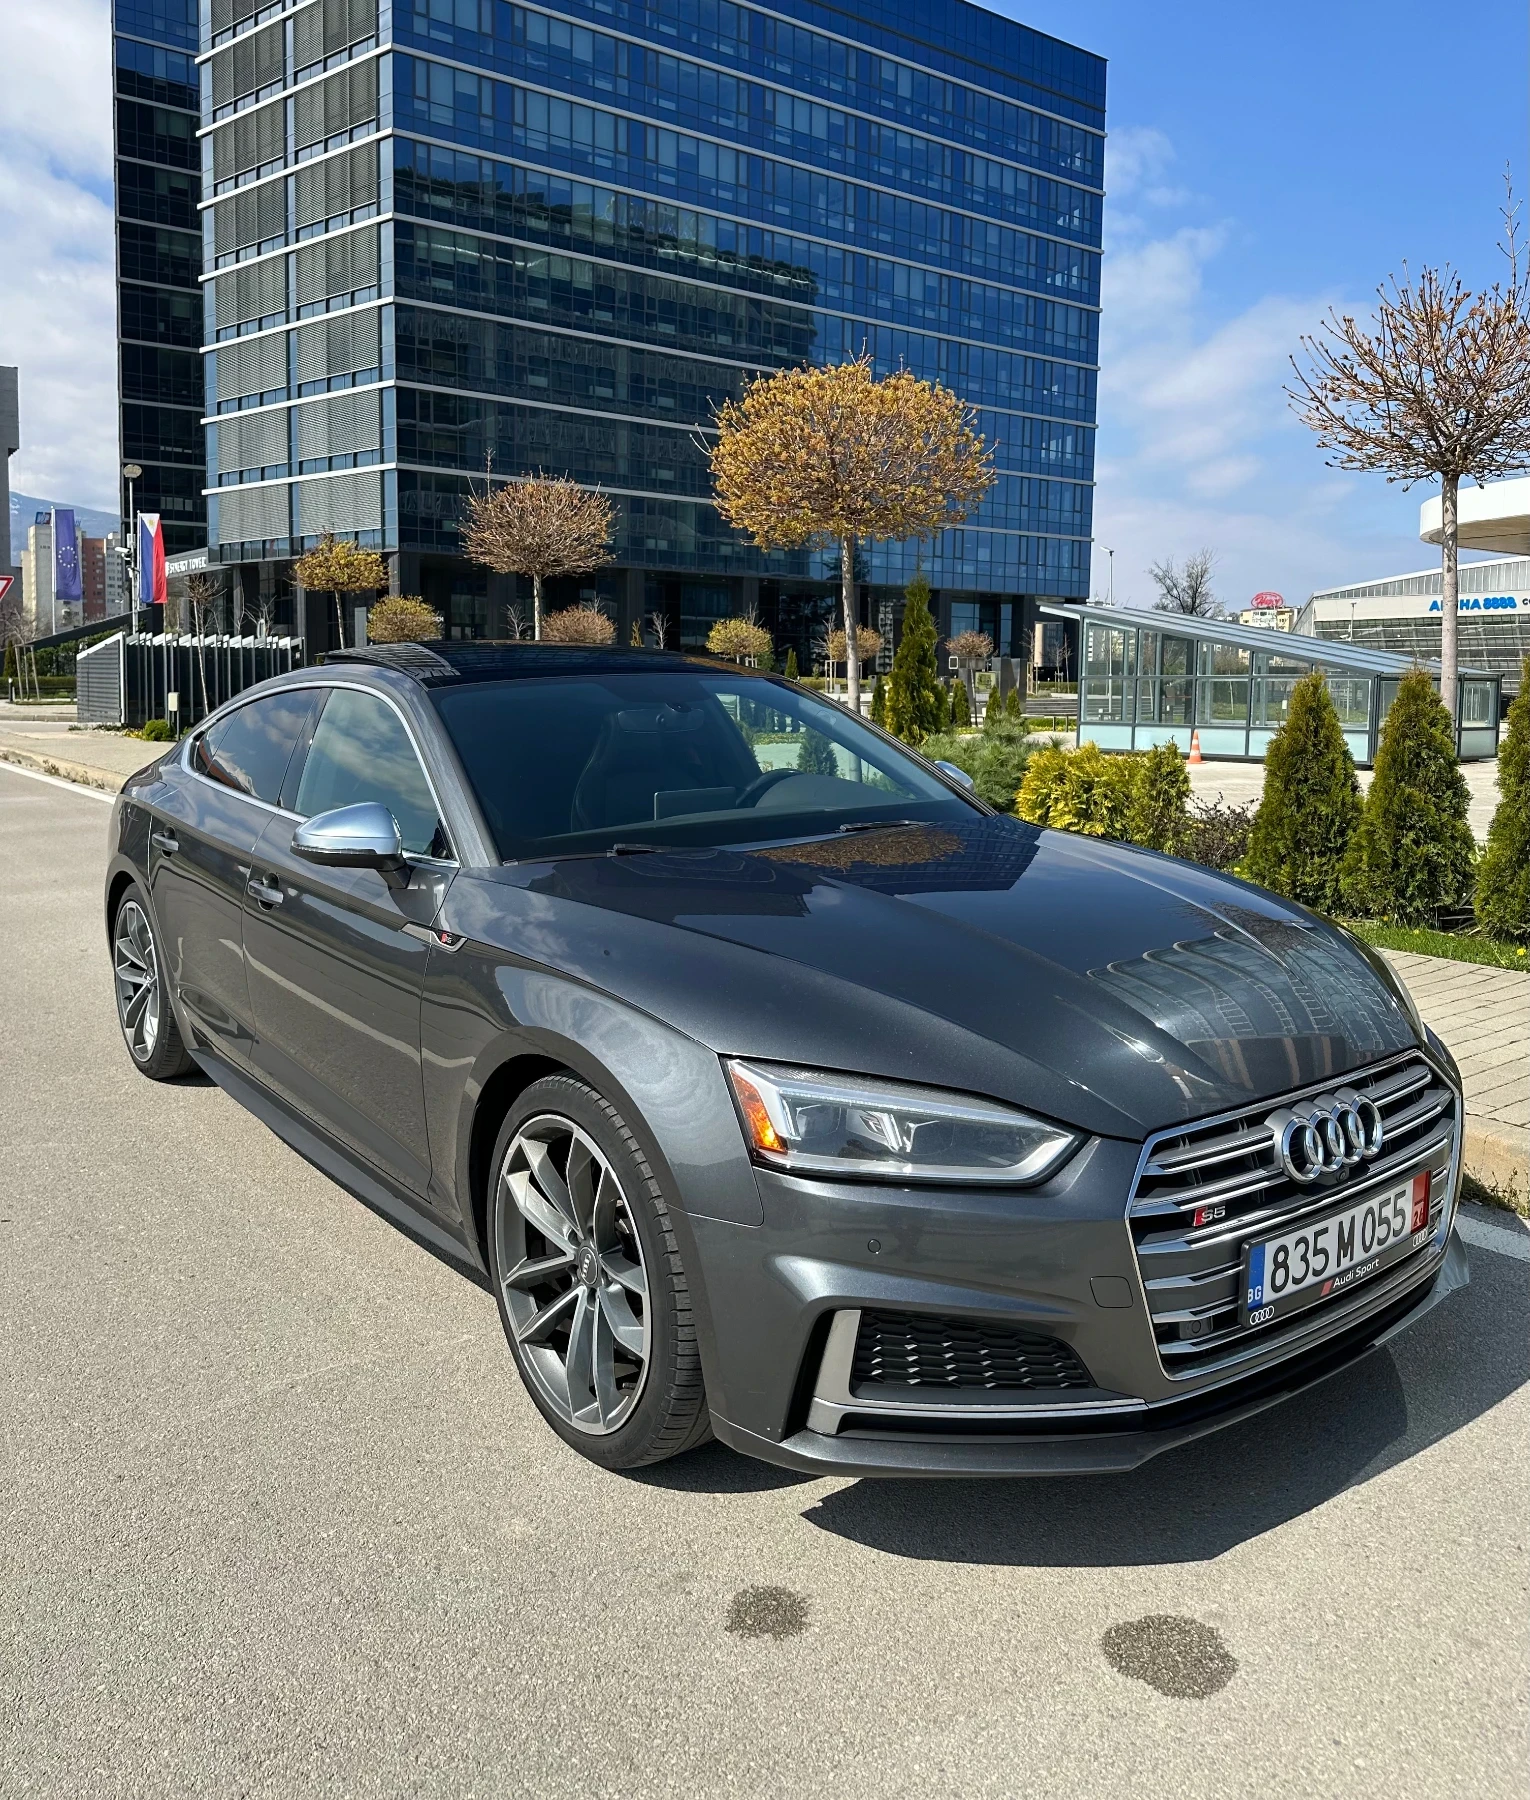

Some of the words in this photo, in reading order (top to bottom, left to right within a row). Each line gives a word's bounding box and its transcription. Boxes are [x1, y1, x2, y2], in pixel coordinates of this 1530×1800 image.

[1201, 1205, 1226, 1222] S5
[1270, 1226, 1330, 1294] 835
[1336, 1215, 1356, 1268] M
[1361, 1189, 1407, 1254] 055
[1332, 1271, 1354, 1288] Audi
[1355, 1258, 1380, 1280] Sport
[1248, 1285, 1262, 1304] BG
